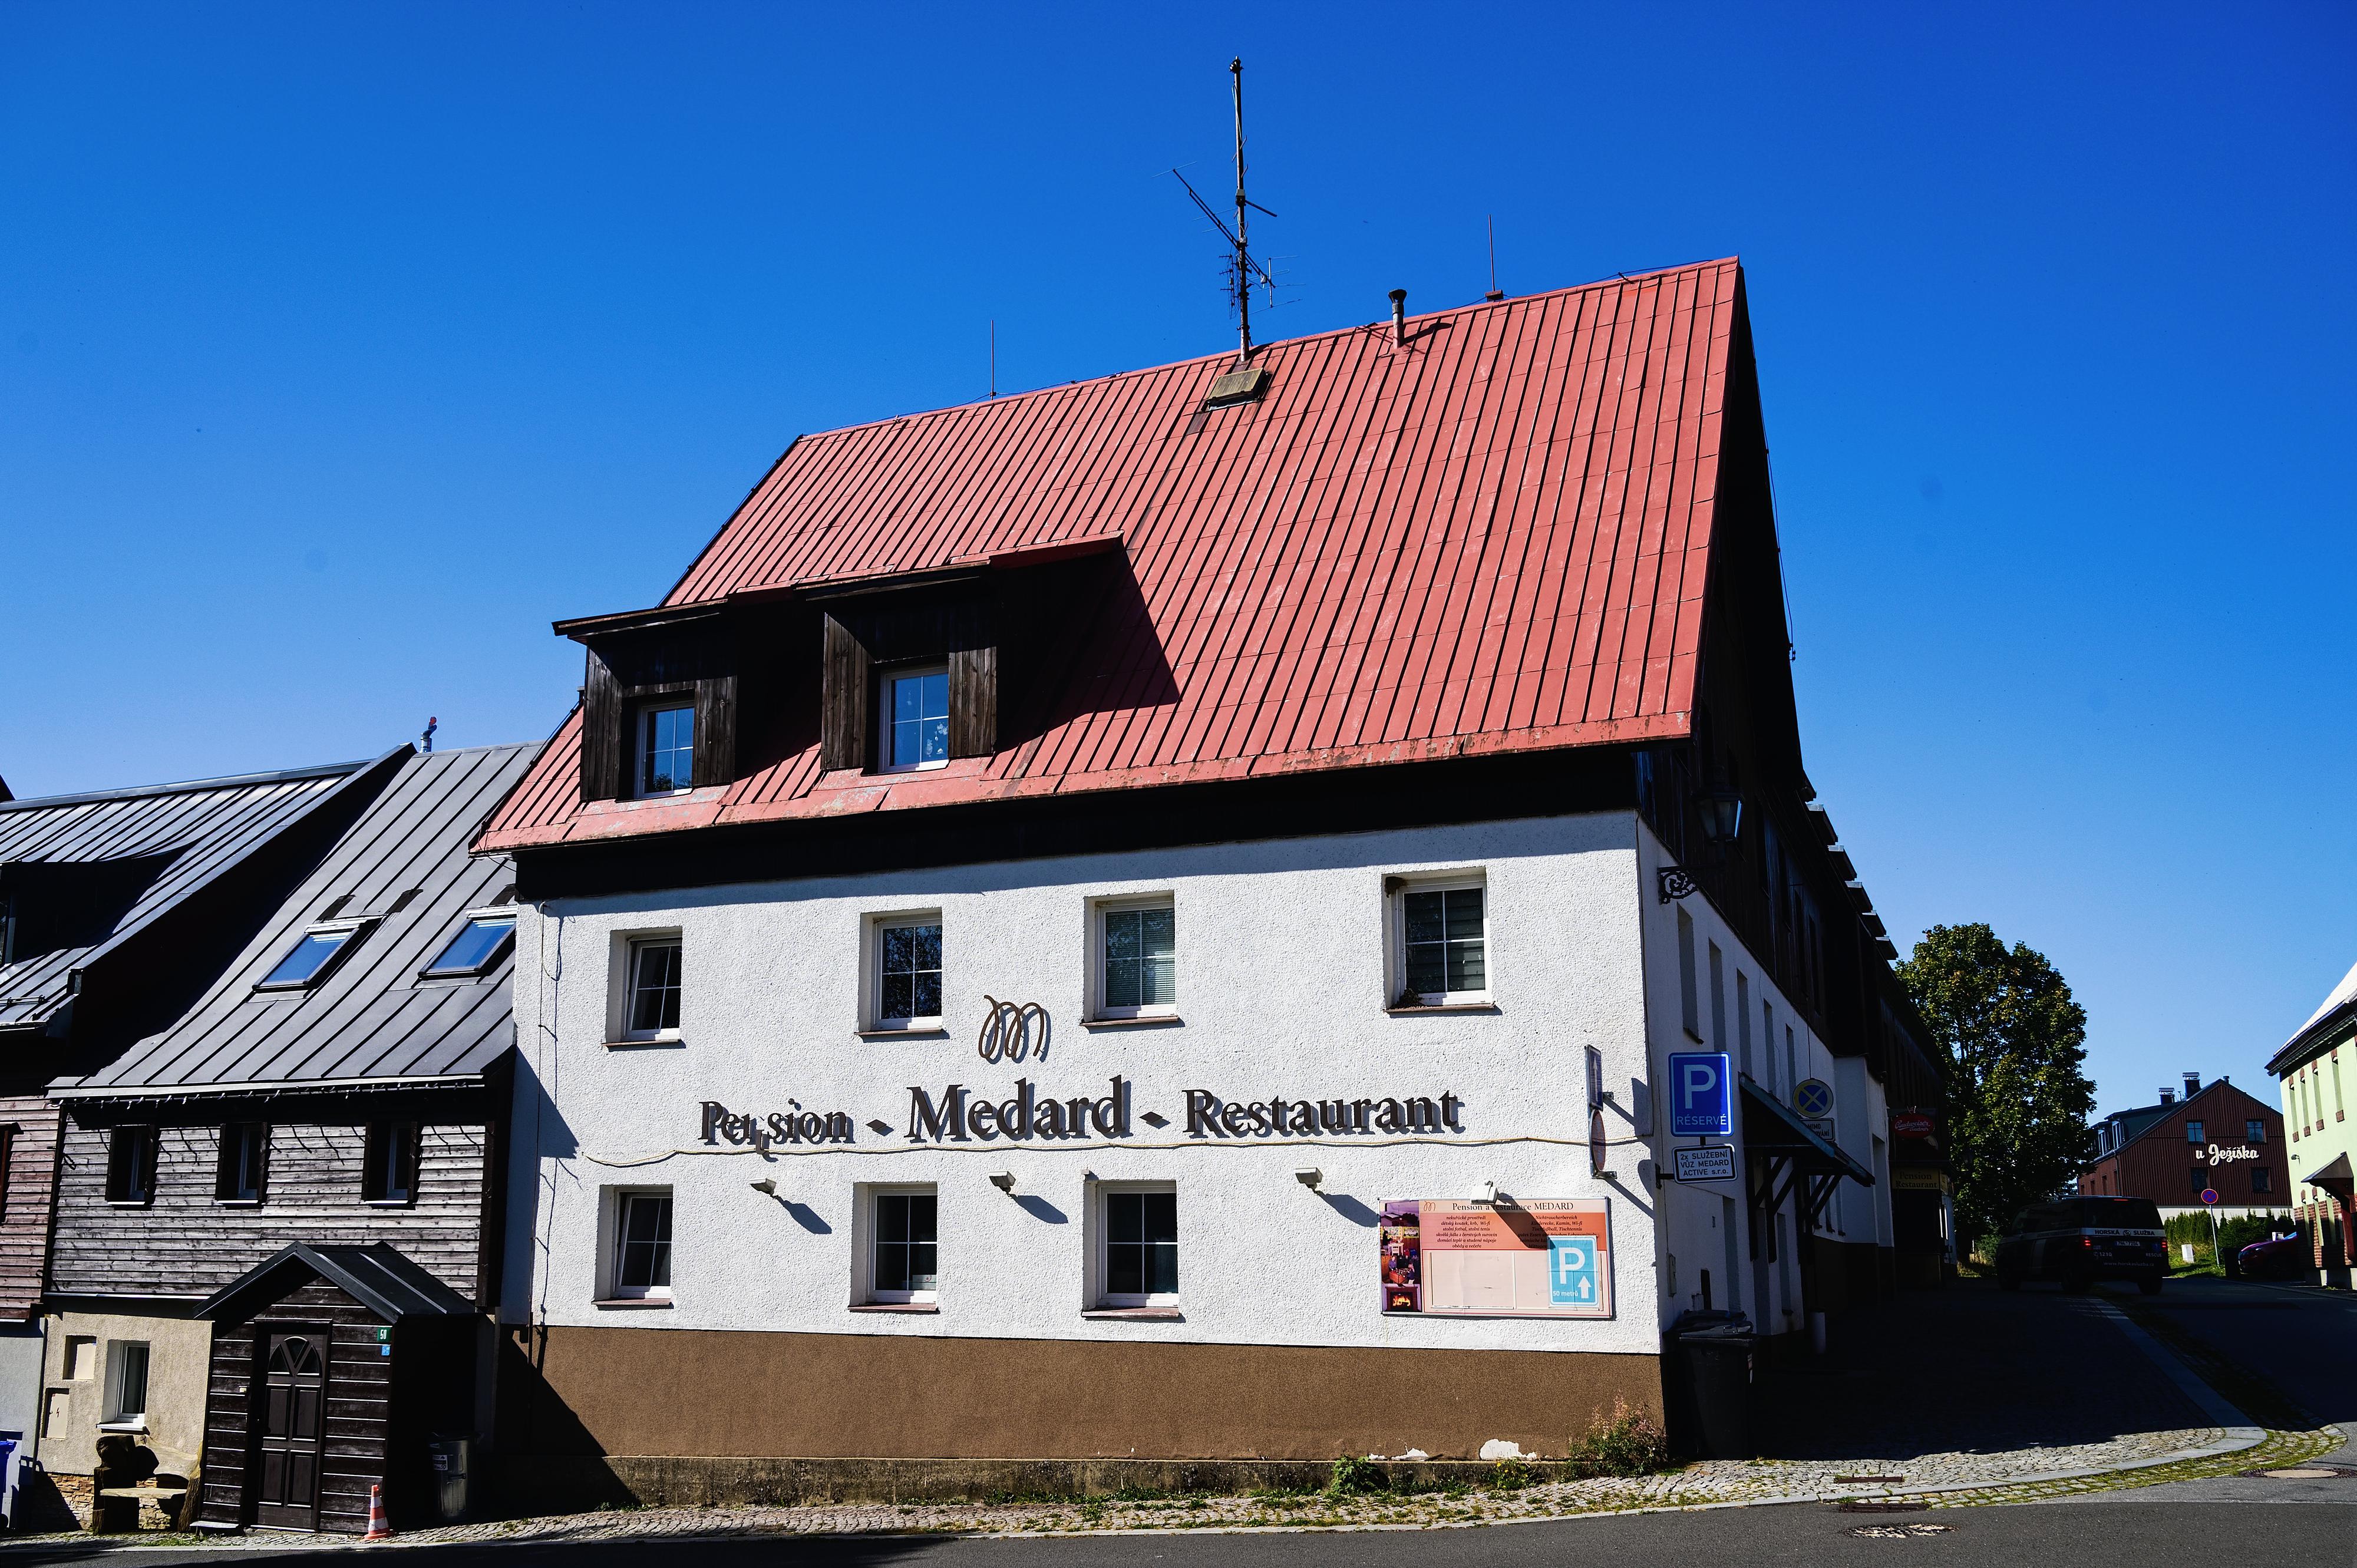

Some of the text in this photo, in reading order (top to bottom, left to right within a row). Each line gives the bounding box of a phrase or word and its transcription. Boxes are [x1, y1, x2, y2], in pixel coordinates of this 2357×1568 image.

[1683, 1064, 1716, 1109] P
[906, 1074, 1126, 1138] Medard
[1181, 1088, 1459, 1133] Restaurant
[1676, 1113, 1727, 1125] RÉSERVÉ
[1692, 1150, 1728, 1159] SLUŽEBNÍ
[2196, 1144, 2259, 1166] u Ježíška
[1680, 1159, 1729, 1168] VŮZ MEDARD
[1899, 1171, 1932, 1180] Pension
[1558, 1246, 1585, 1284] P
[379, 1329, 387, 1340] 50
